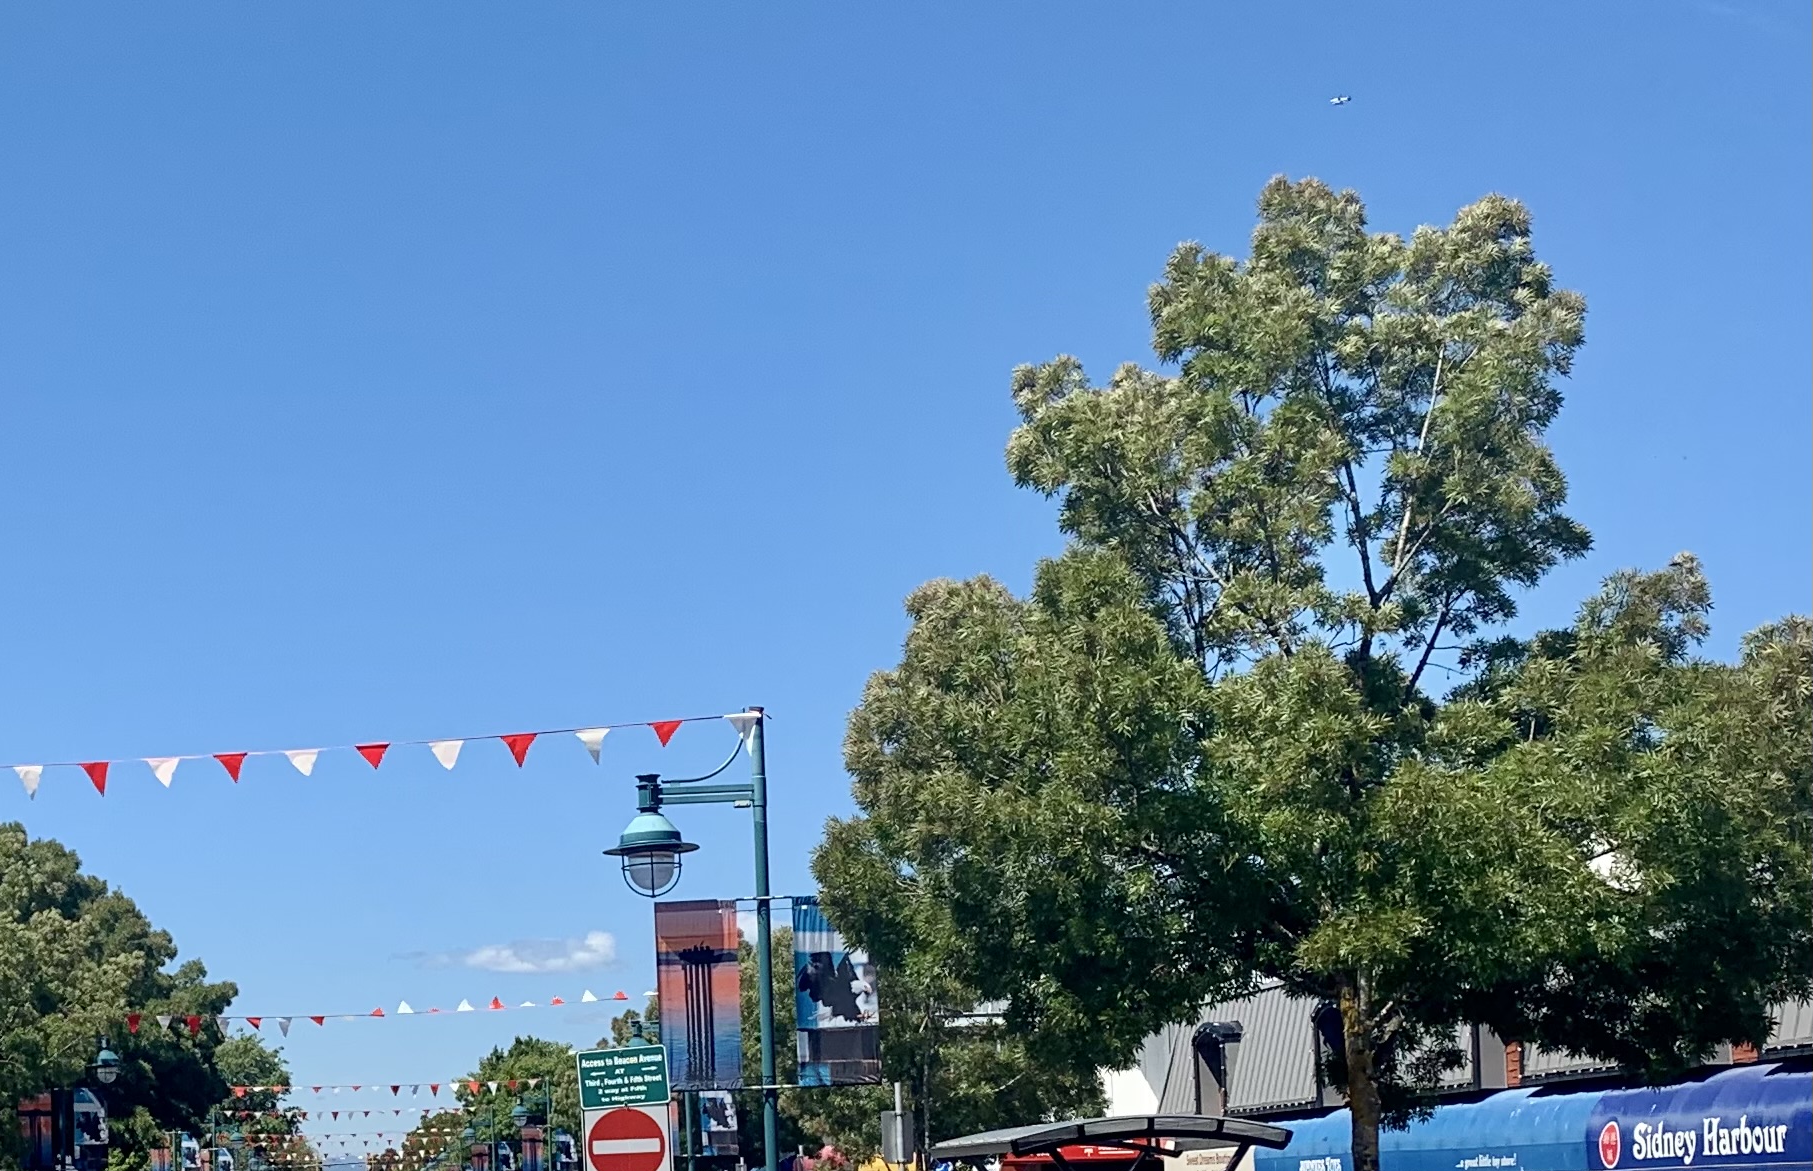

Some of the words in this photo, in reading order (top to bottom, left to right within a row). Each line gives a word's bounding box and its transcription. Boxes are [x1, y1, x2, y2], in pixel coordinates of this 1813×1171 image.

[581, 1059, 605, 1068] Access
[606, 1058, 613, 1066] to
[614, 1056, 638, 1065] Beacon
[639, 1054, 663, 1063] Avenue
[604, 1078, 623, 1086] Fourth
[624, 1076, 629, 1084] &
[644, 1074, 662, 1082] Street
[1633, 1119, 1696, 1165] Sidney
[1702, 1114, 1788, 1156] Harbour
